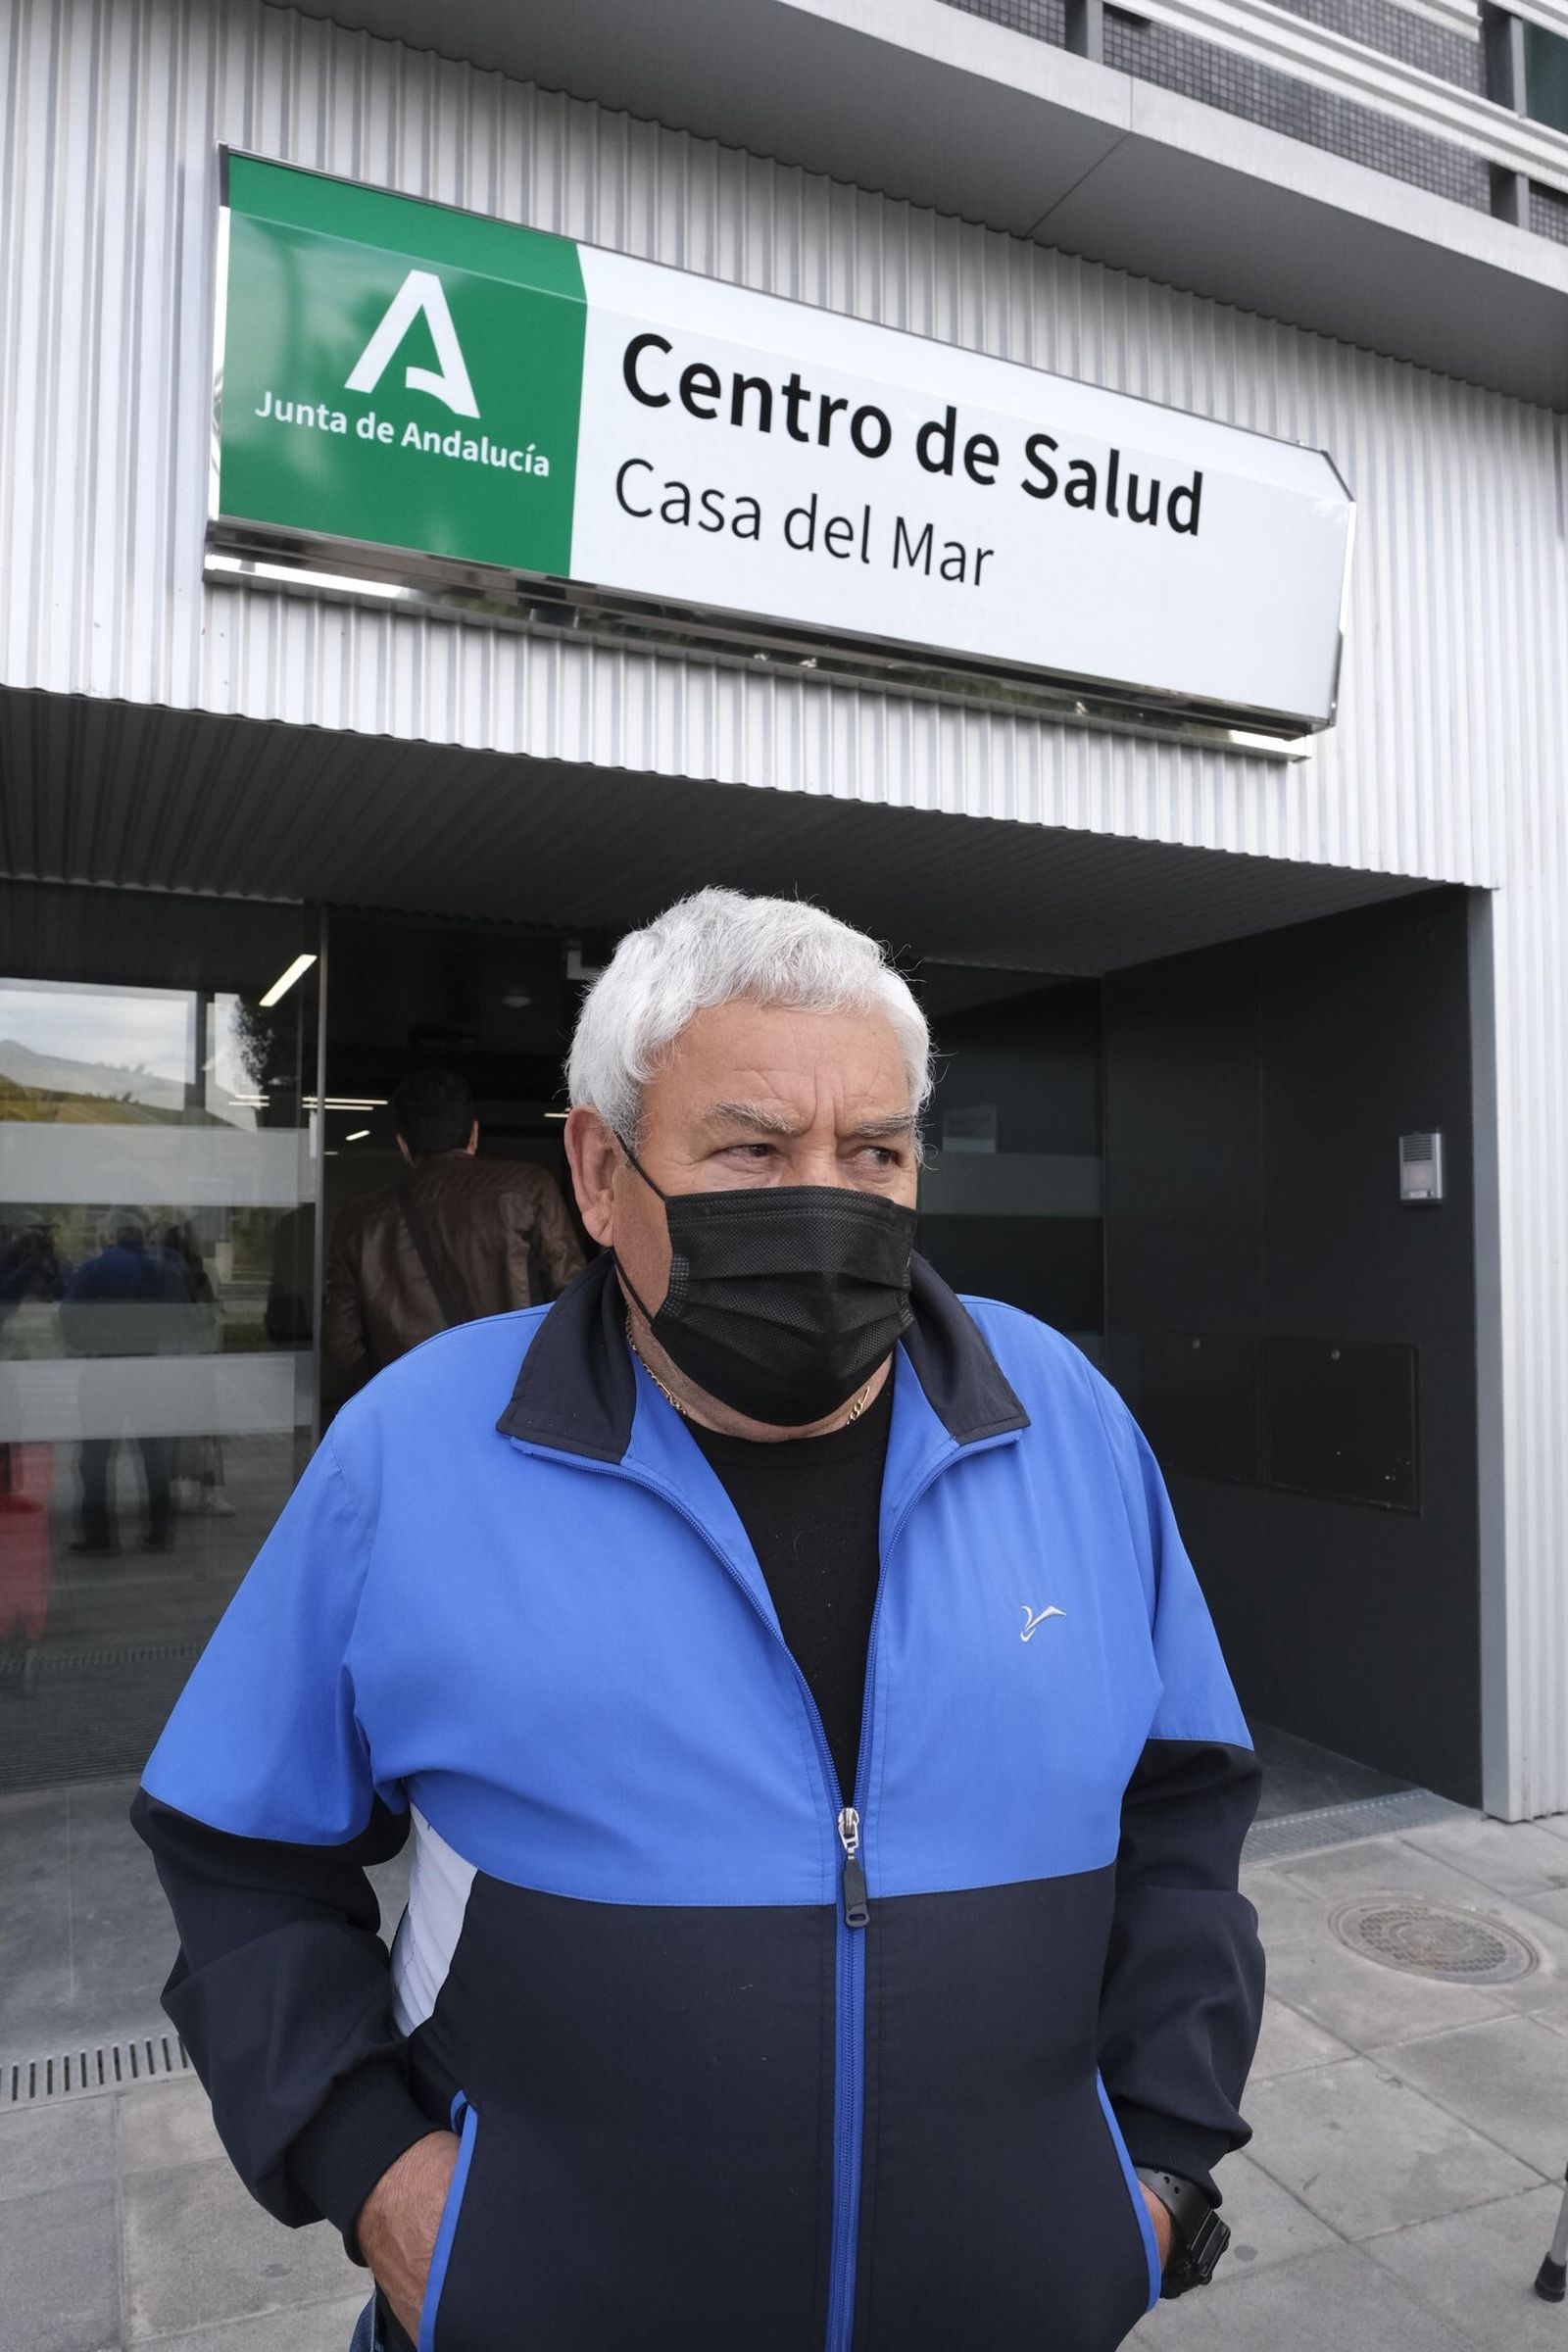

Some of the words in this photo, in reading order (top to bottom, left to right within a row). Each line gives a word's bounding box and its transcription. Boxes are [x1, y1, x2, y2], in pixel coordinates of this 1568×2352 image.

[254, 390, 347, 434] Junta
[356, 411, 394, 443] de
[401, 421, 550, 477] Andalucía
[622, 332, 892, 459] Centro
[915, 405, 1000, 486] de
[1020, 433, 1203, 536] Salud
[614, 458, 761, 541] Casa
[783, 492, 871, 564] del
[893, 515, 995, 586] Mar
